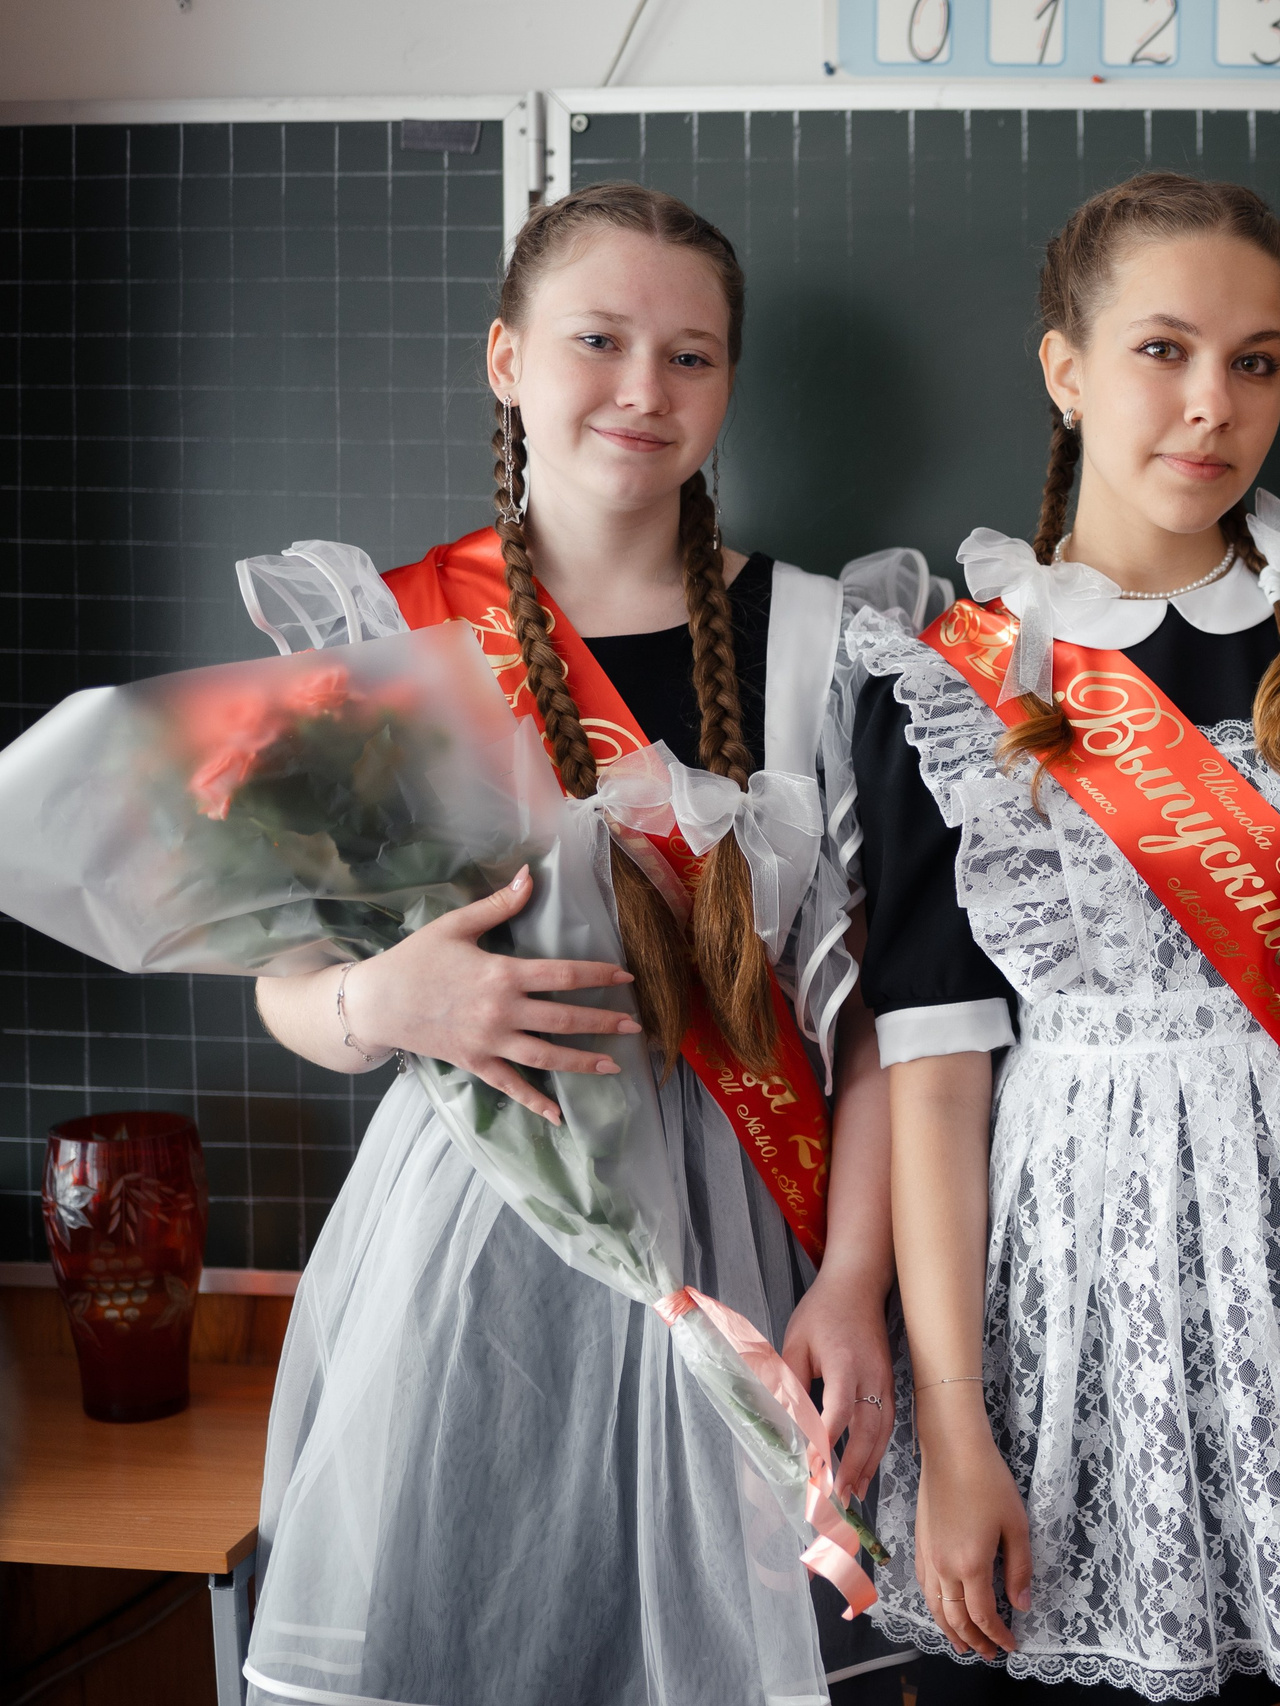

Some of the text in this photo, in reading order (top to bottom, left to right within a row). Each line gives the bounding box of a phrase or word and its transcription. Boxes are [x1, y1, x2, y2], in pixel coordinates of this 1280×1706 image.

[908, 0, 951, 62] 0
[1034, 0, 1060, 65] 1
[1130, 0, 1178, 65] 2
[1076, 777, 1117, 815] класс
[1197, 758, 1275, 850] Иванова
